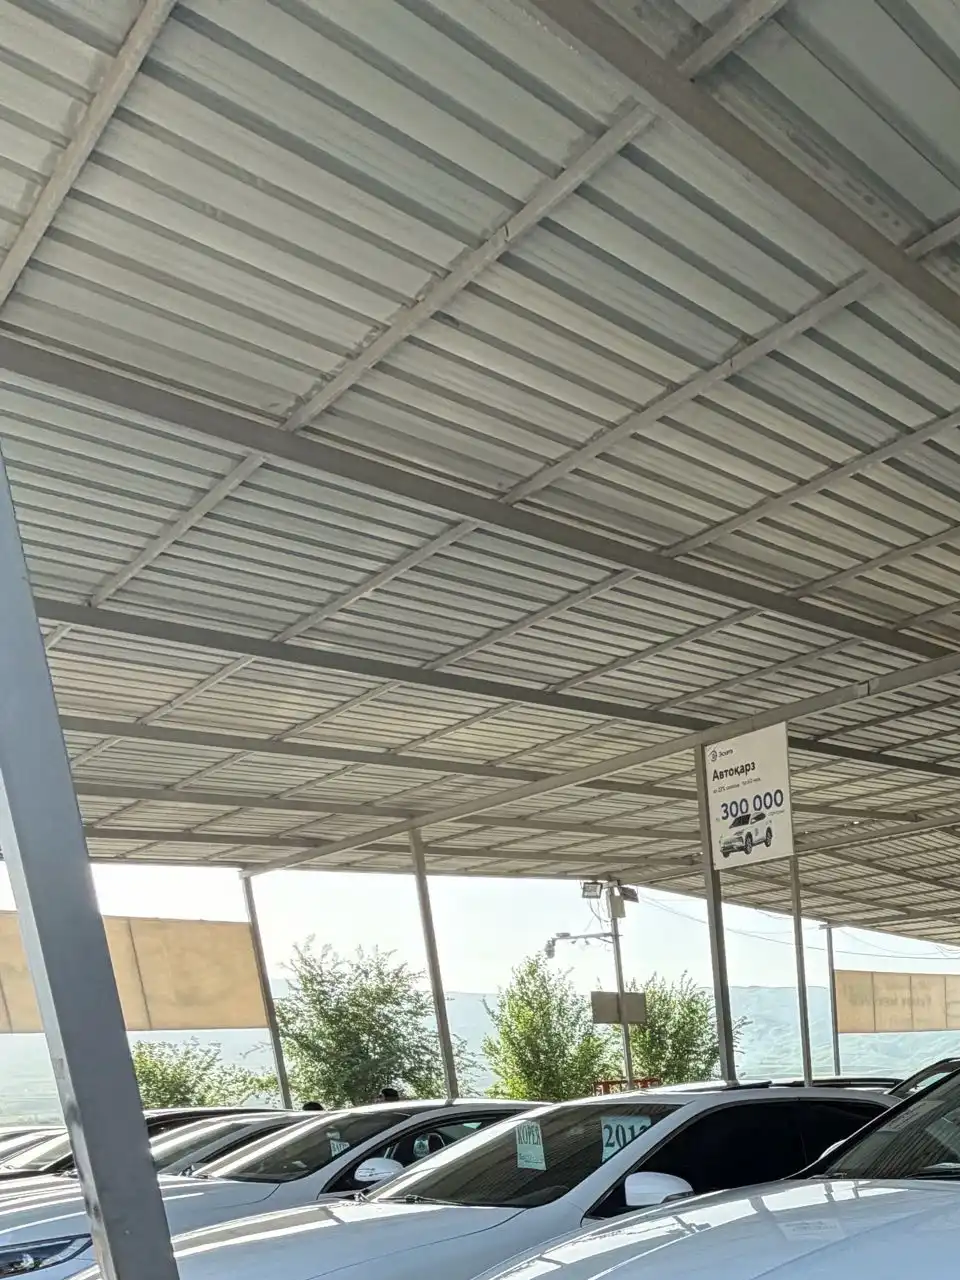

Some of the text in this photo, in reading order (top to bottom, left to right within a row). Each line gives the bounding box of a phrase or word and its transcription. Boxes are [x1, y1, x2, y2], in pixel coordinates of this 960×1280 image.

[712, 761, 756, 781] Автоқарз
[721, 789, 783, 820] 300 000
[517, 1122, 543, 1146] КОРЕЯ
